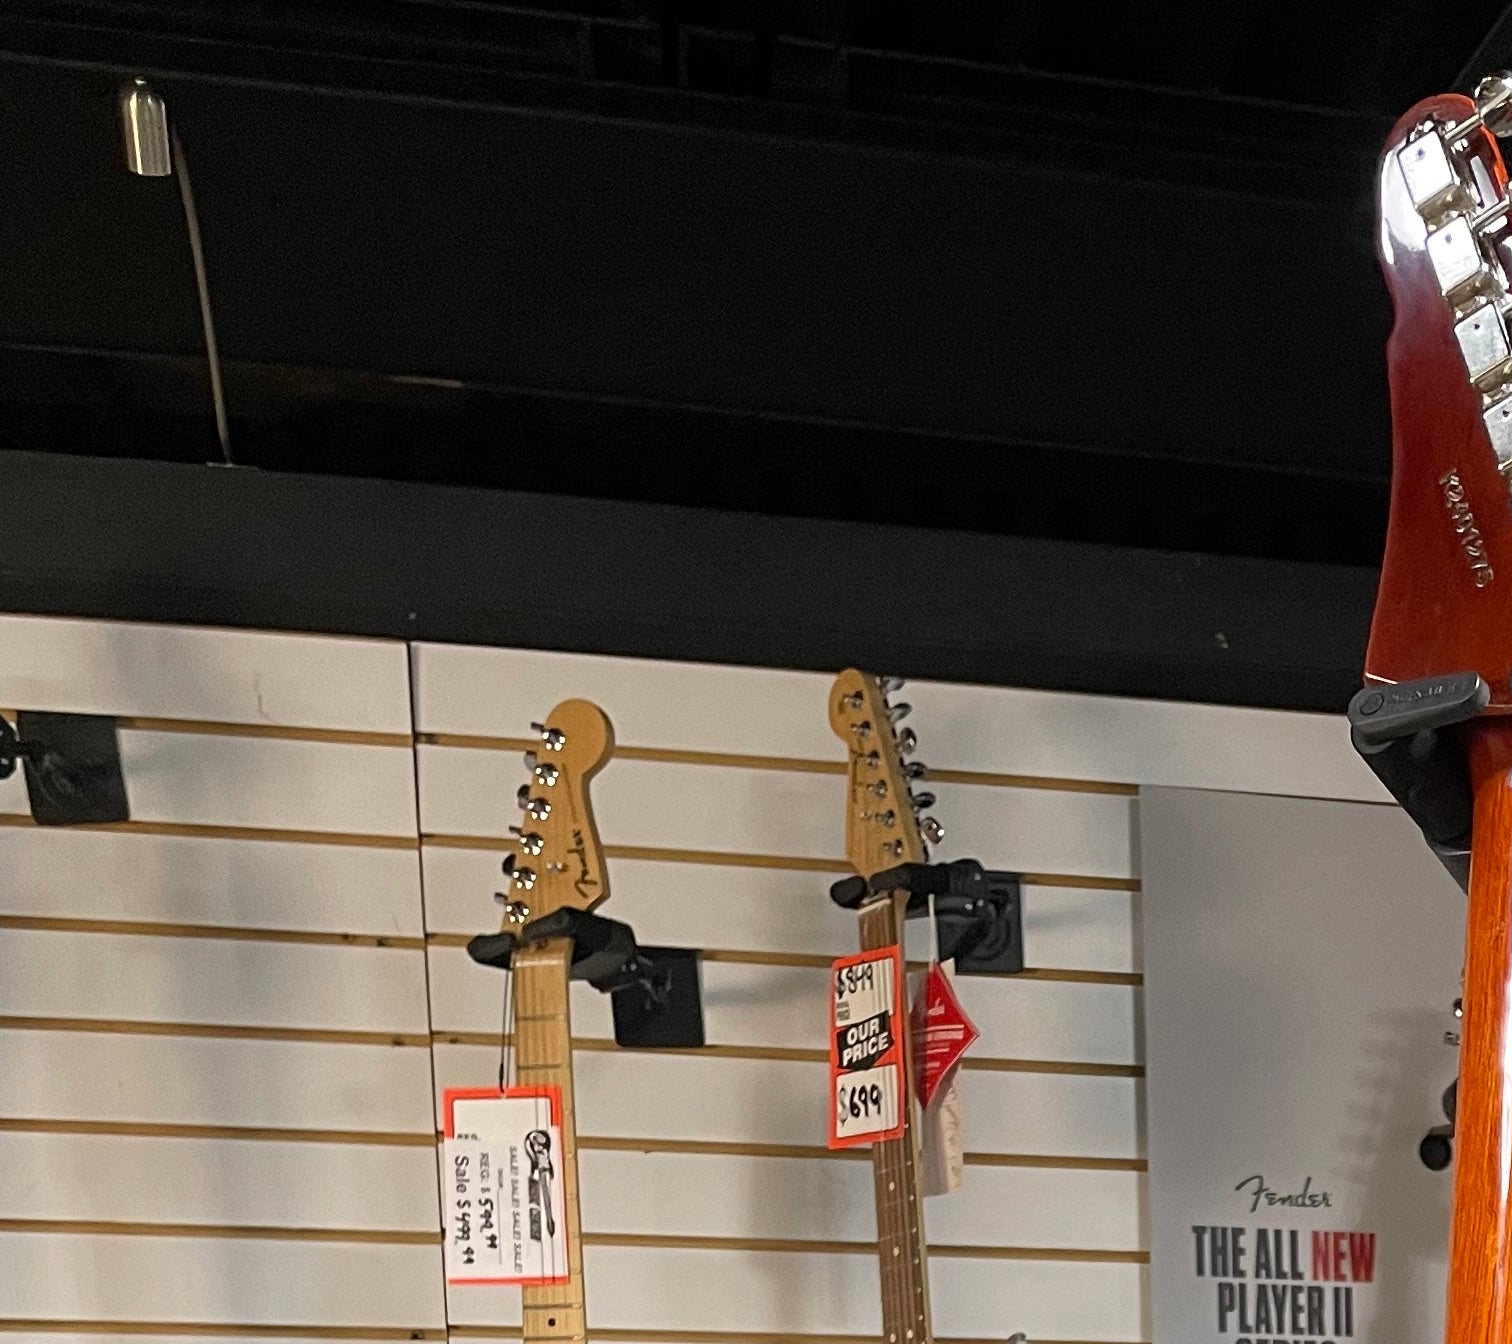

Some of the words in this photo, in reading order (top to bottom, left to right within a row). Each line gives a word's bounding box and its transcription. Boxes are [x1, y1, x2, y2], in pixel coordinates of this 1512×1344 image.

[843, 1031, 889, 1067] PRICE
[847, 1018, 879, 1044] OUR
[838, 1083, 881, 1128] $699
[454, 1155, 470, 1193] Sale
[1234, 1175, 1333, 1213] Fender
[1192, 1225, 1246, 1278] THE
[1255, 1228, 1304, 1280] ALL
[1311, 1231, 1376, 1283] NEW
[1217, 1282, 1326, 1336] PLAYER
[1333, 1287, 1353, 1337] II
